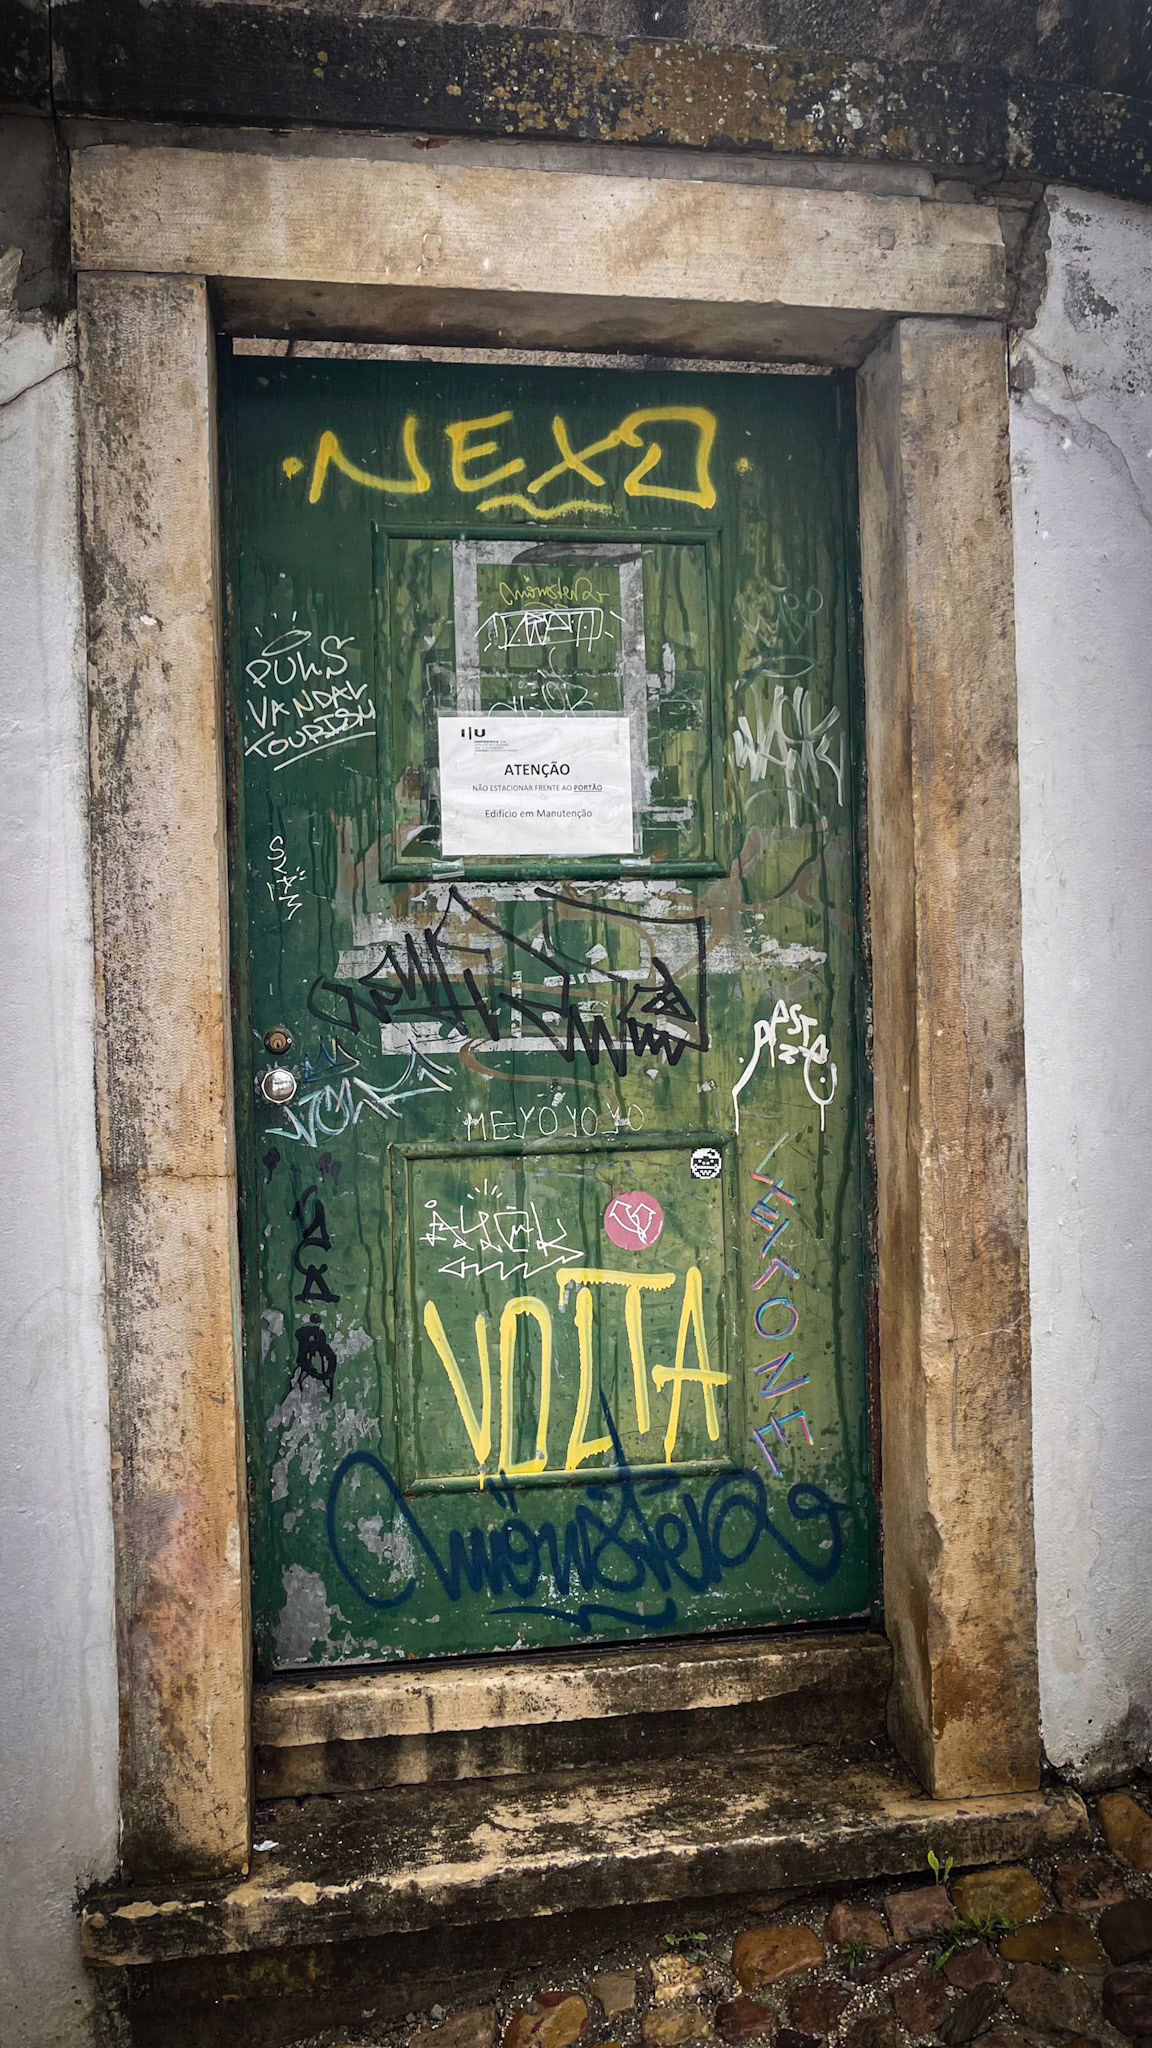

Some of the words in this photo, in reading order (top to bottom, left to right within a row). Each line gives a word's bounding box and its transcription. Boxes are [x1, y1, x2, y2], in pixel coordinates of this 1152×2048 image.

[247, 680, 368, 729] VANDAL
[504, 761, 570, 778] ATENÇÃO
[472, 784, 489, 792] NÃO
[490, 784, 533, 792] ESTACIONAR
[535, 784, 560, 792] FRENTE
[561, 784, 573, 792] AO
[574, 783, 603, 792] PORTÃO
[485, 809, 518, 819] Edifício
[519, 811, 535, 819] em
[536, 809, 593, 820] Manutenção
[423, 1266, 732, 1475] VOLTA
